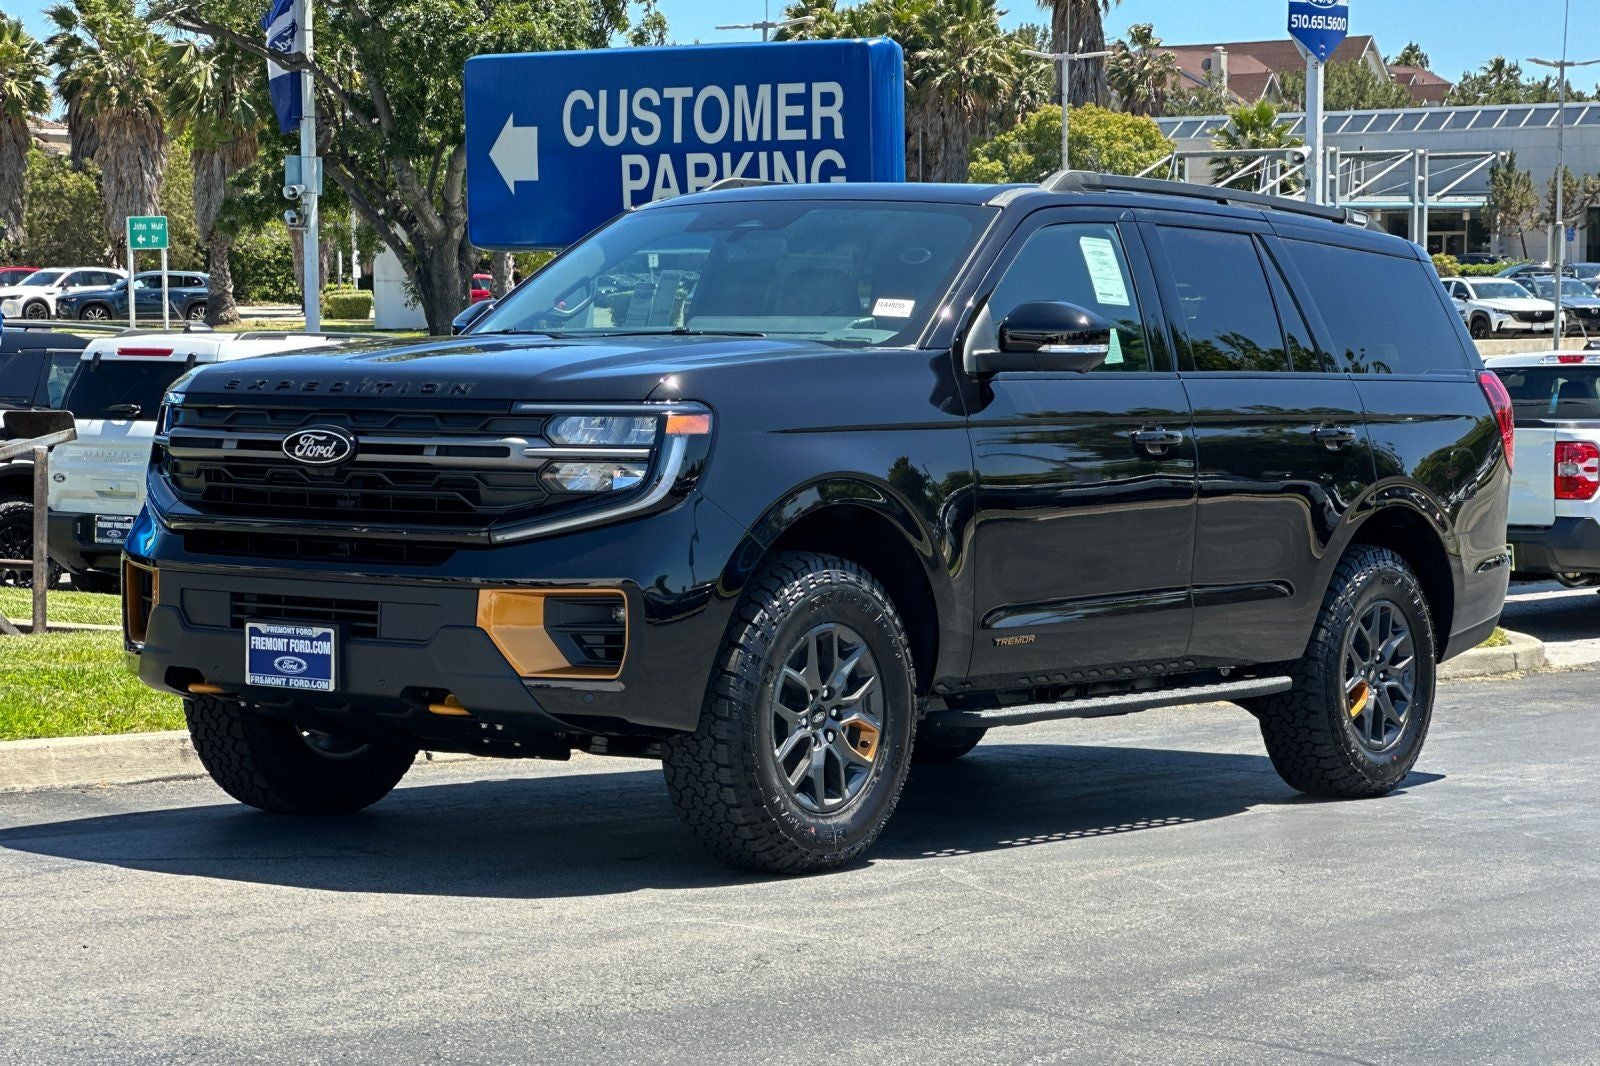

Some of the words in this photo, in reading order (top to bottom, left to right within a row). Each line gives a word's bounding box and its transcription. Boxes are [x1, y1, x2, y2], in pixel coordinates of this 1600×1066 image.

[1291, 14, 1346, 31] 510.651.5600
[562, 81, 846, 148] CUSTOMER
[621, 148, 848, 209] PARKING
[132, 222, 146, 230] John
[150, 222, 163, 230] Muir
[224, 378, 473, 394] EXPEDITION
[294, 433, 336, 459] Ford
[266, 626, 295, 635] FREMONT
[296, 627, 313, 636] FORD
[251, 636, 288, 651] FREMONT
[289, 639, 331, 654] FORD.COM
[994, 634, 1035, 647] TREMOR
[281, 660, 298, 670] Ford
[250, 675, 287, 686] FREMONT
[289, 678, 329, 690] FORD.COM
